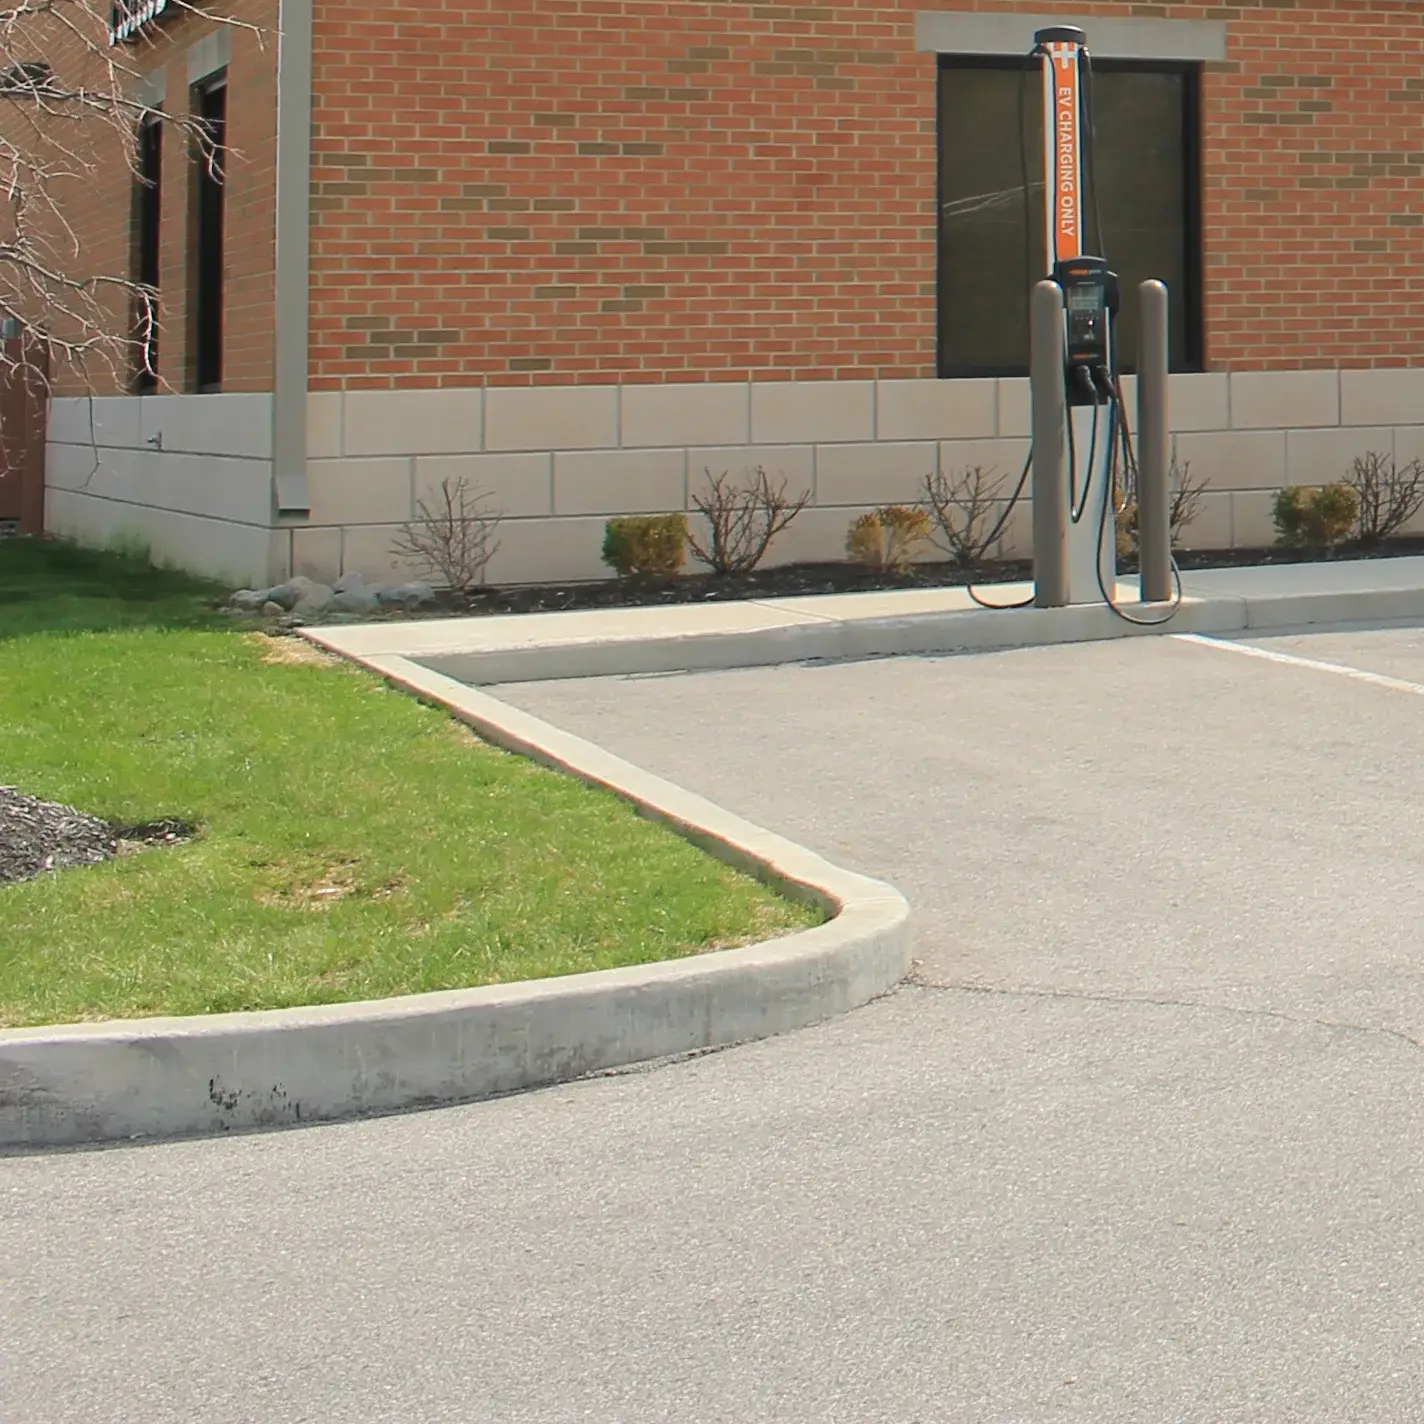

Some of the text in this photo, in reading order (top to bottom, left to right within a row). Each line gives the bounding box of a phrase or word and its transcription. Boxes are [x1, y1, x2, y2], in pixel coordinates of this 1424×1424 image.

[1058, 87, 1076, 236] EV CHARGING ONLY
